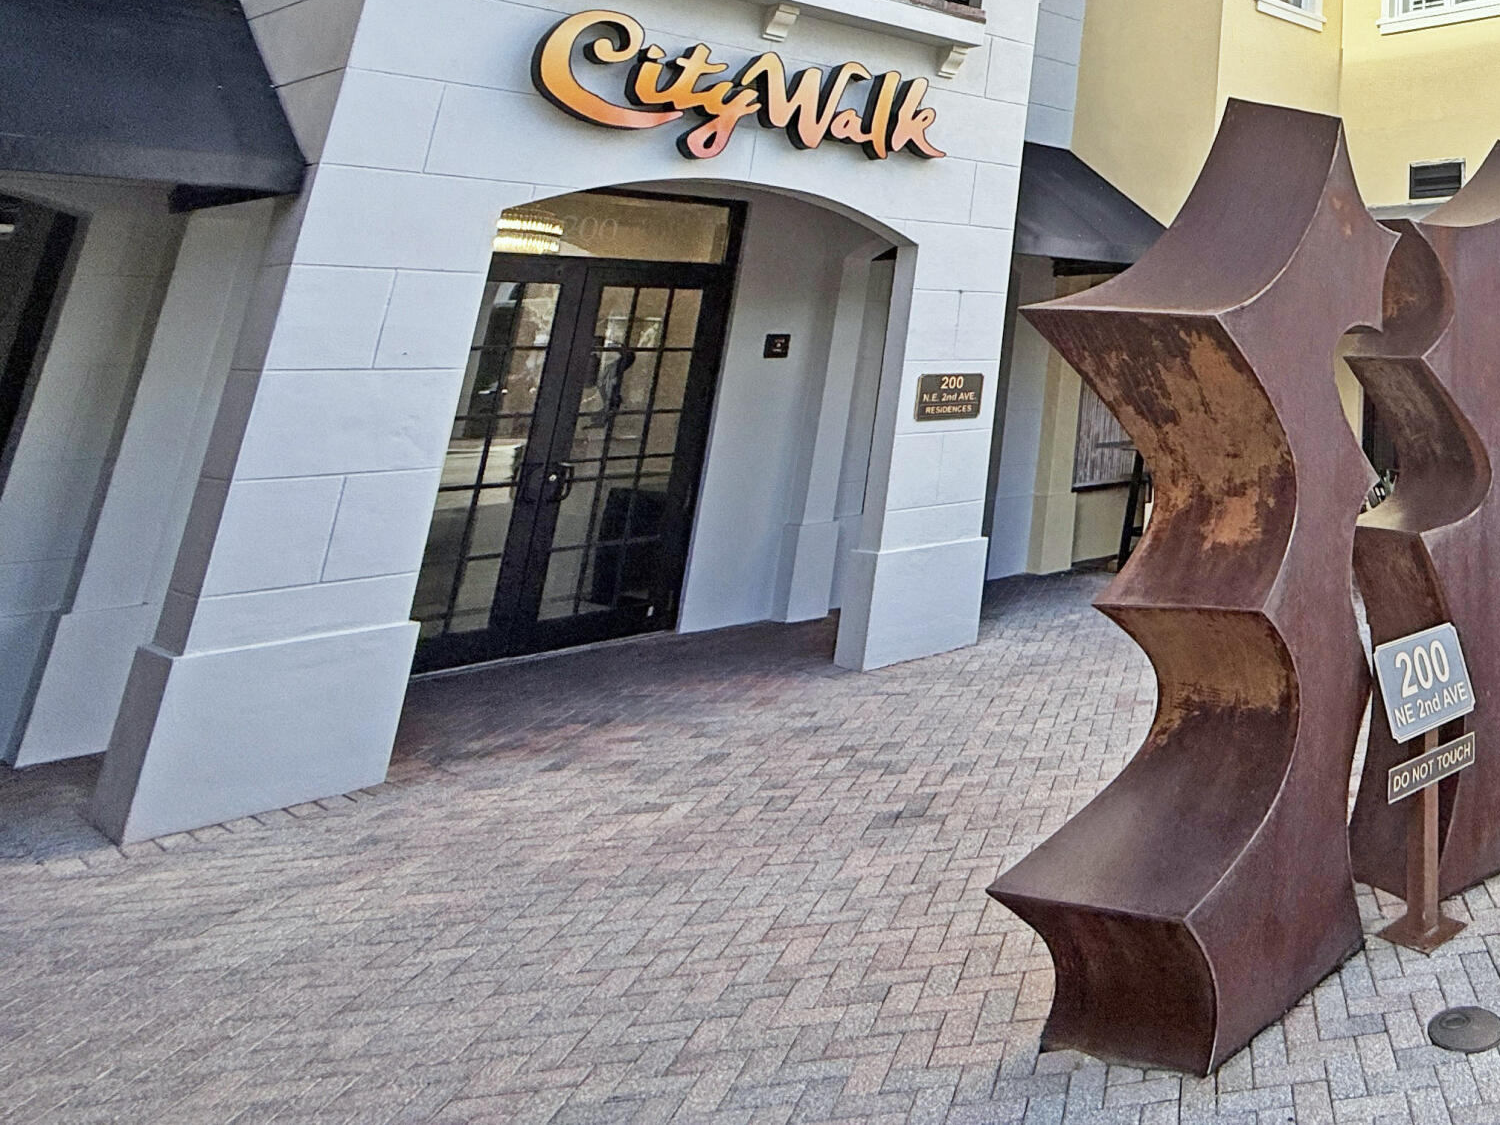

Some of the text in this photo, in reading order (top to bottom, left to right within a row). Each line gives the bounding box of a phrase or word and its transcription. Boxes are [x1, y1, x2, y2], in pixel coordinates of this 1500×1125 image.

[940, 376, 964, 389] 200
[941, 392, 957, 401] 2nd
[925, 405, 972, 414] RESIDENCES
[1395, 639, 1450, 698] 200
[1394, 681, 1468, 728] NE 2nd AVE
[1393, 742, 1471, 792] DO NOT TOUCH
